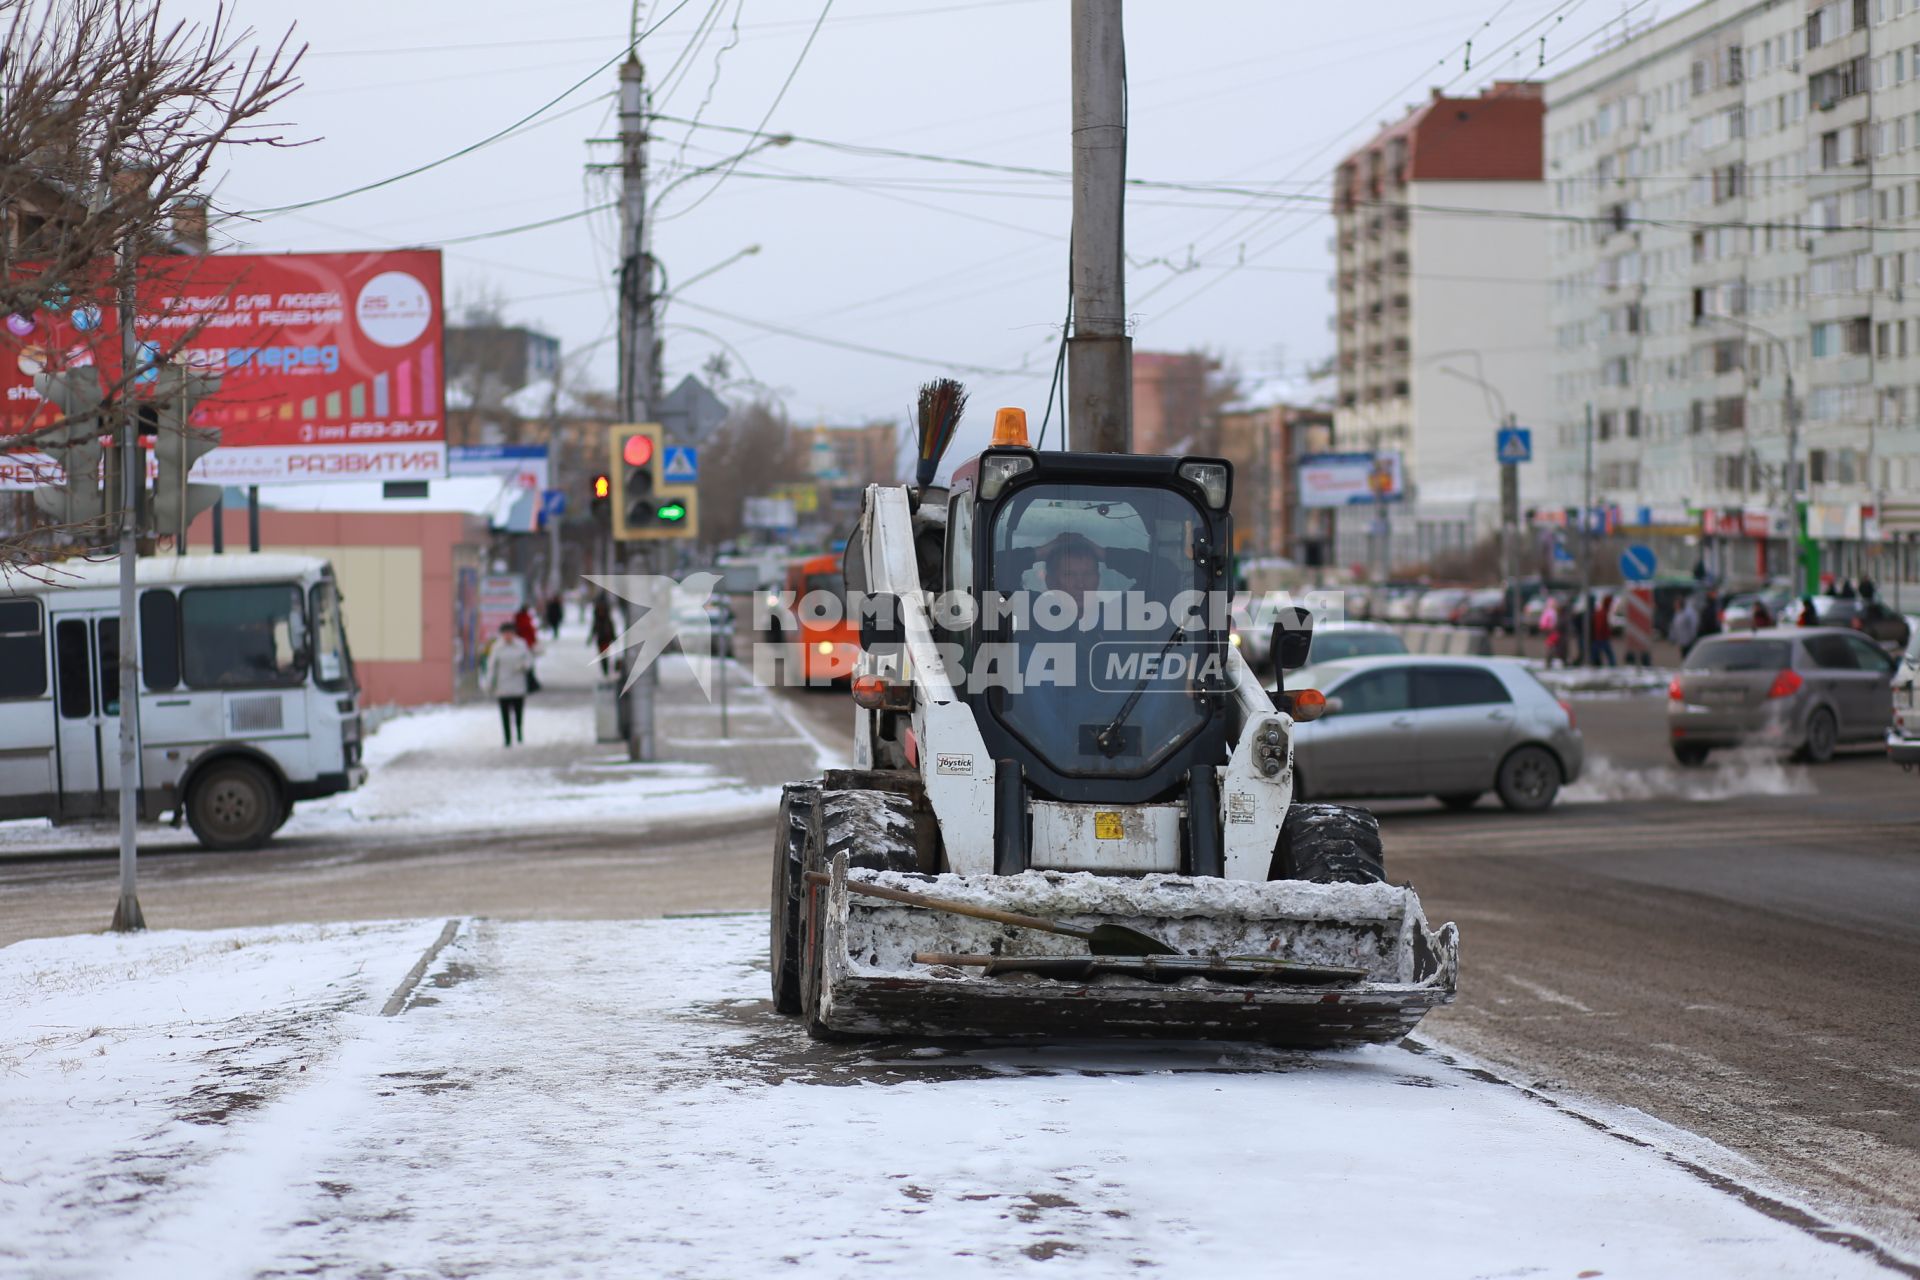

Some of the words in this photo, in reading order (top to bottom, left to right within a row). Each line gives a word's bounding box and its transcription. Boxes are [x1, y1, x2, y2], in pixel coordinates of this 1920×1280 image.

[235, 293, 273, 310] ДЛЯ
[258, 309, 343, 326] РЕШЕНИЯ
[287, 451, 440, 474] РАЗВИТИЯ
